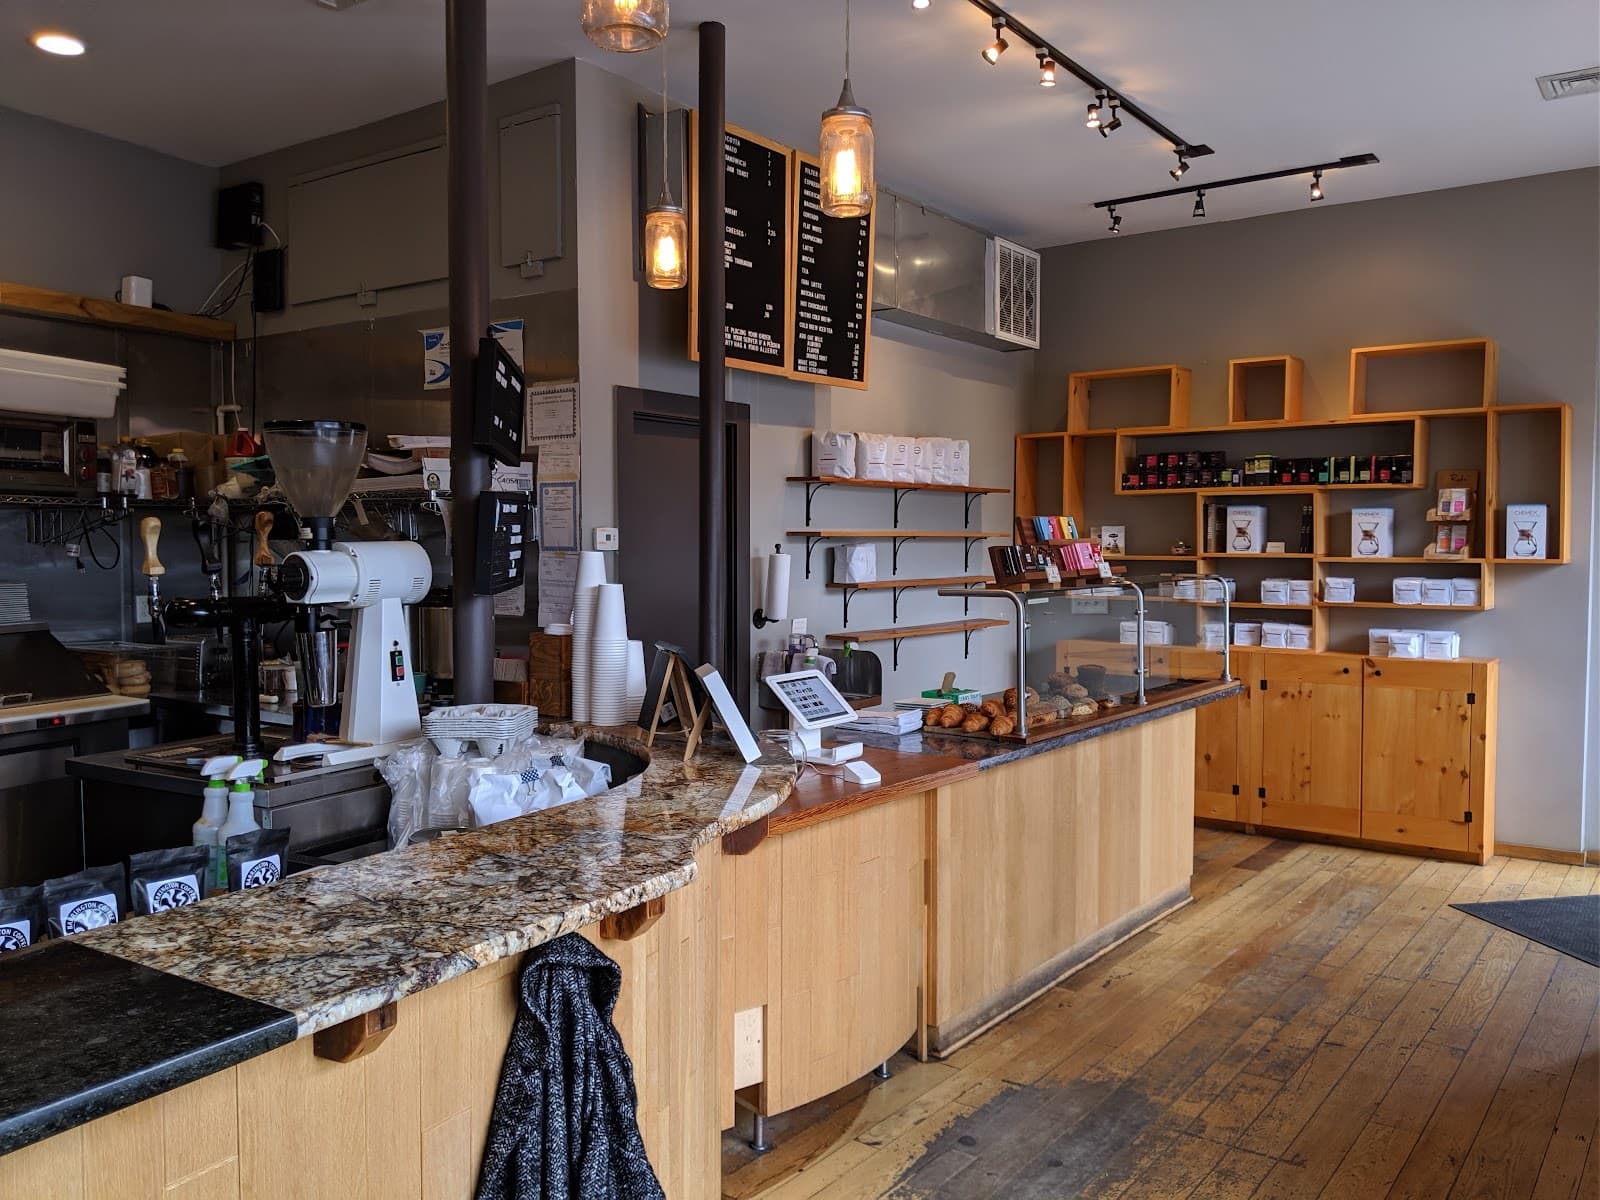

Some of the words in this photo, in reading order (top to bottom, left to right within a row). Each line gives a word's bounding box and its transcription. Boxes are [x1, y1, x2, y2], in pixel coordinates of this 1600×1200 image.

[181, 884, 198, 901] COFFEE
[66, 902, 97, 930] BARINGTON
[98, 903, 116, 921] COFFEE
